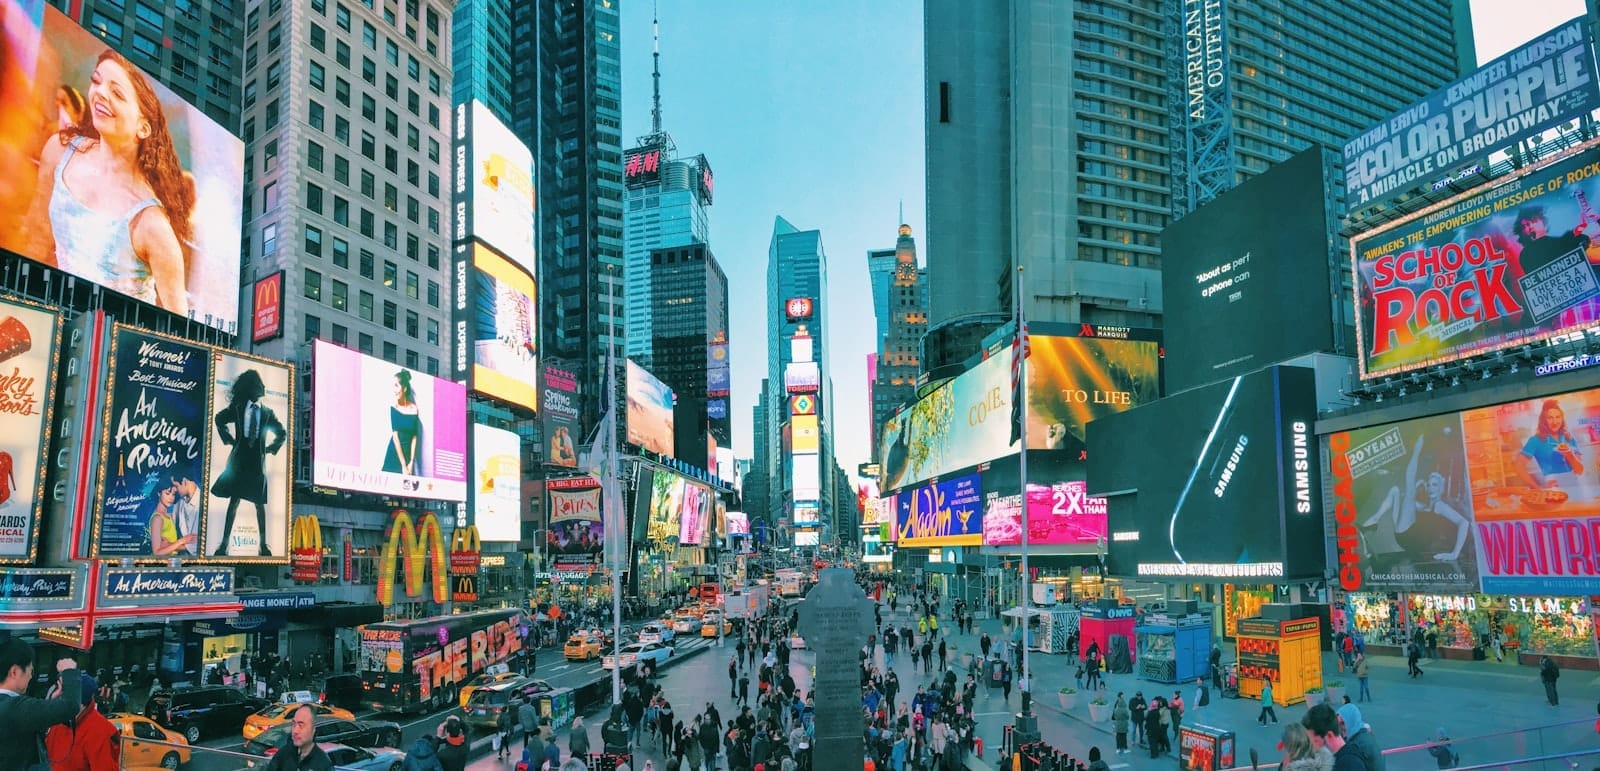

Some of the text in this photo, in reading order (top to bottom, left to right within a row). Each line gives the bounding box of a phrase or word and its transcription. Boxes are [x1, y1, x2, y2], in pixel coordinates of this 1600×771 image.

[1186, 9, 1204, 118] AMERICAN
[1390, 102, 1429, 134] ERIVO
[1444, 60, 1506, 107] JENNIFER
[1510, 22, 1582, 73] HUDSON
[1360, 44, 1590, 186] COLOR PURPLE
[457, 145, 466, 193] EXPRESS
[1345, 157, 1361, 194] THE
[1371, 157, 1432, 198] MIRACLE
[1437, 148, 1460, 169] ON
[1406, 229, 1424, 245] THE
[1426, 204, 1491, 238] EMPOWERING
[1494, 183, 1545, 213] MESSAGE
[1548, 176, 1563, 192] OF
[1424, 180, 1521, 226] ANDREW LLOYD WEBBER
[1221, 263, 1232, 273] as
[1232, 252, 1251, 271] perf
[1373, 236, 1505, 289] SCHOOL
[1537, 252, 1581, 281] WARNED!
[457, 260, 466, 310] EXPRESS
[1202, 288, 1208, 297] a
[1208, 278, 1233, 297] phone
[1234, 271, 1250, 283] can
[1434, 271, 1457, 289] OF
[1533, 266, 1582, 297] THERE'S A
[1533, 287, 1559, 307] LOVE
[1559, 274, 1588, 295] STORY
[1370, 263, 1523, 357] ROCK
[1543, 301, 1552, 311] IN
[1552, 294, 1569, 307] THIS
[1570, 286, 1584, 298] ONE
[1440, 320, 1472, 337] MUSICAL
[138, 340, 191, 365] Winner!
[457, 321, 466, 371] EXPRESS
[139, 358, 150, 368] 4
[1537, 357, 1589, 374] OUTFRONT
[128, 369, 197, 391] Best Musical!
[133, 387, 158, 419] An
[1062, 389, 1088, 403] TO
[1094, 390, 1131, 405] LIFE
[115, 408, 199, 460] American
[1349, 449, 1364, 466] 20
[1364, 431, 1399, 457] YEARS
[126, 442, 178, 475] Paris
[1214, 434, 1249, 498] SAMSUNG
[1293, 421, 1310, 513] SAMSUNG
[1052, 484, 1082, 492] REACHES
[1052, 491, 1083, 515] 2X
[0, 515, 26, 528] ARDS
[899, 484, 952, 540] Aladdin
[1083, 505, 1107, 514] THAN
[1330, 431, 1361, 591] CHICAGO
[0, 528, 25, 536] ICAL
[114, 574, 205, 594] An American Paris
[267, 598, 294, 607] MONEY
[299, 597, 314, 606] ATM
[1425, 595, 1562, 613] GRAND SLAM
[412, 614, 522, 703] THE RIDE
